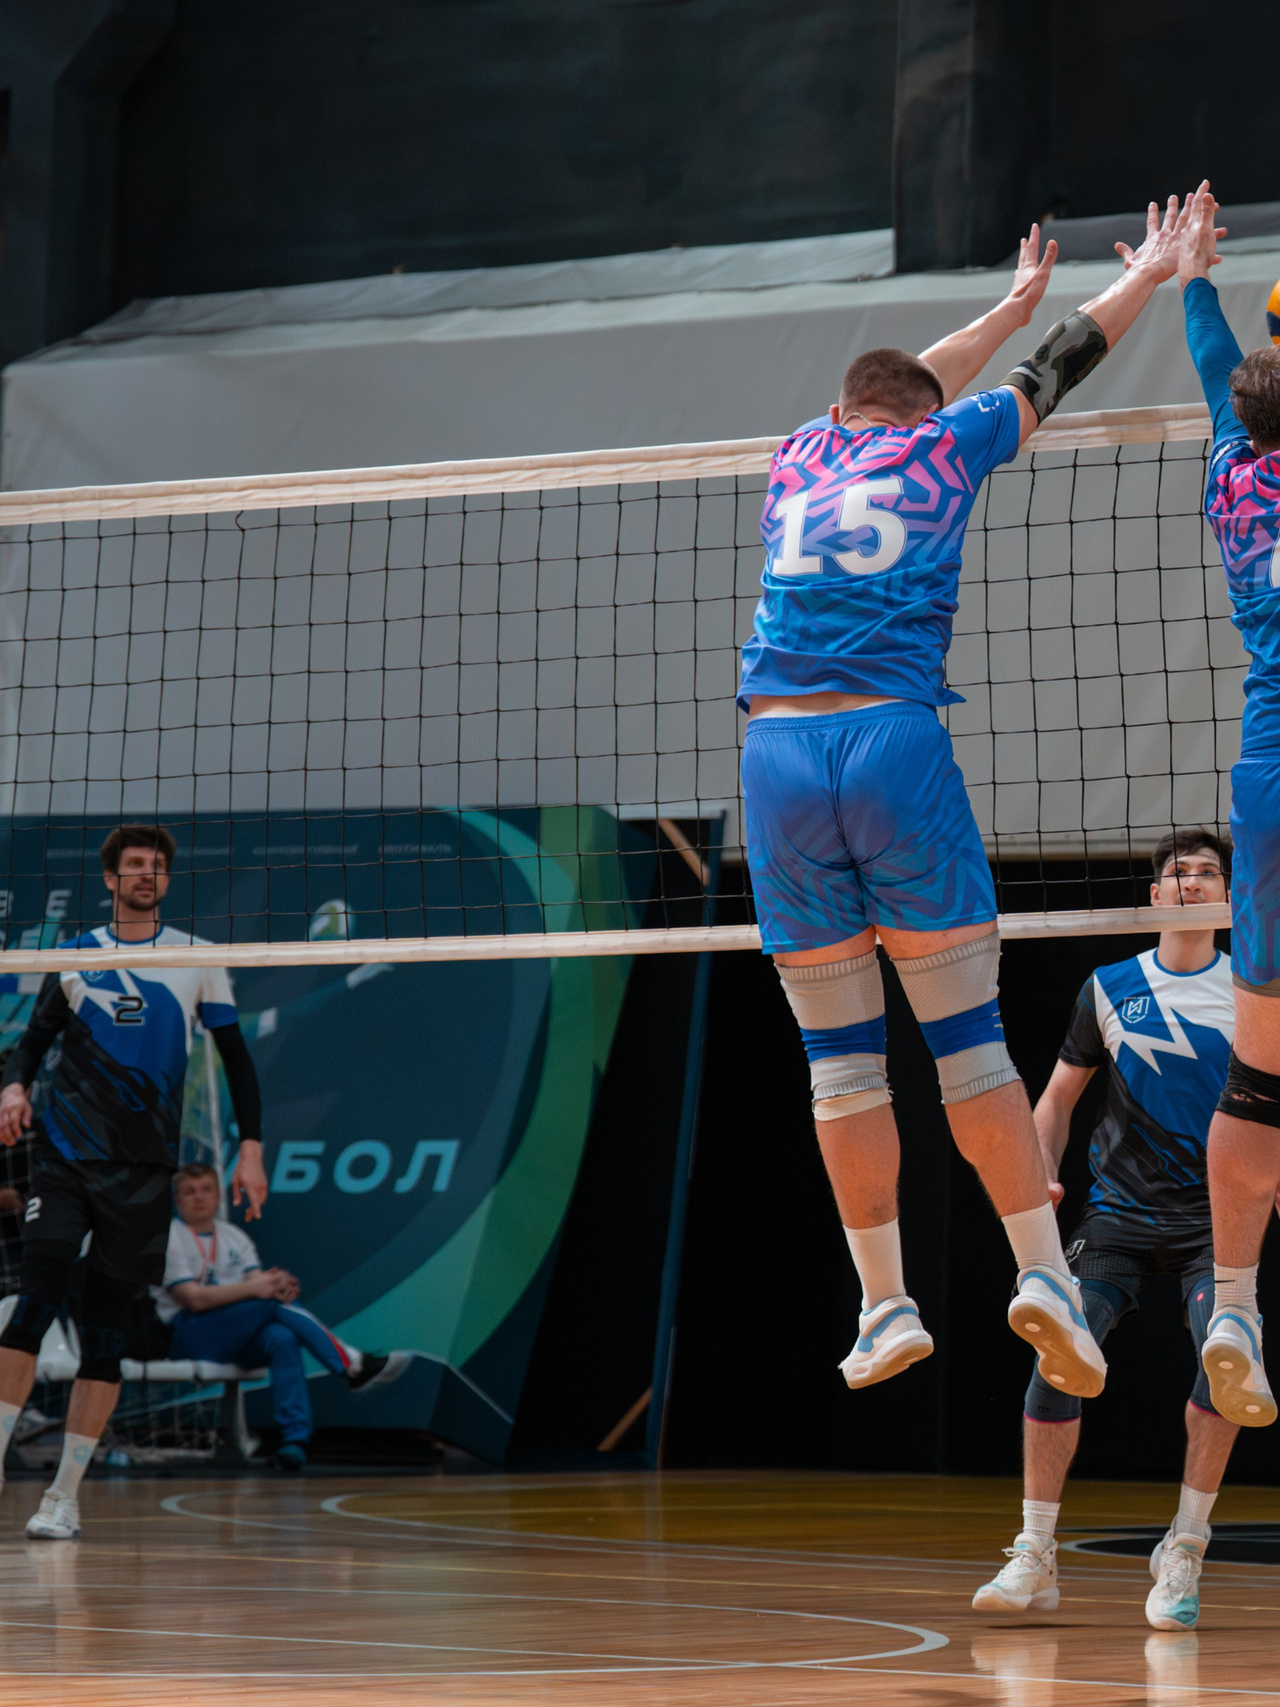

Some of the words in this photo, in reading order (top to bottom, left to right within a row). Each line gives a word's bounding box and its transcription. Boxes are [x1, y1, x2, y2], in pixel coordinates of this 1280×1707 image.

[772, 478, 907, 577] 15
[113, 995, 146, 1026] 2
[24, 1196, 42, 1222] 2
